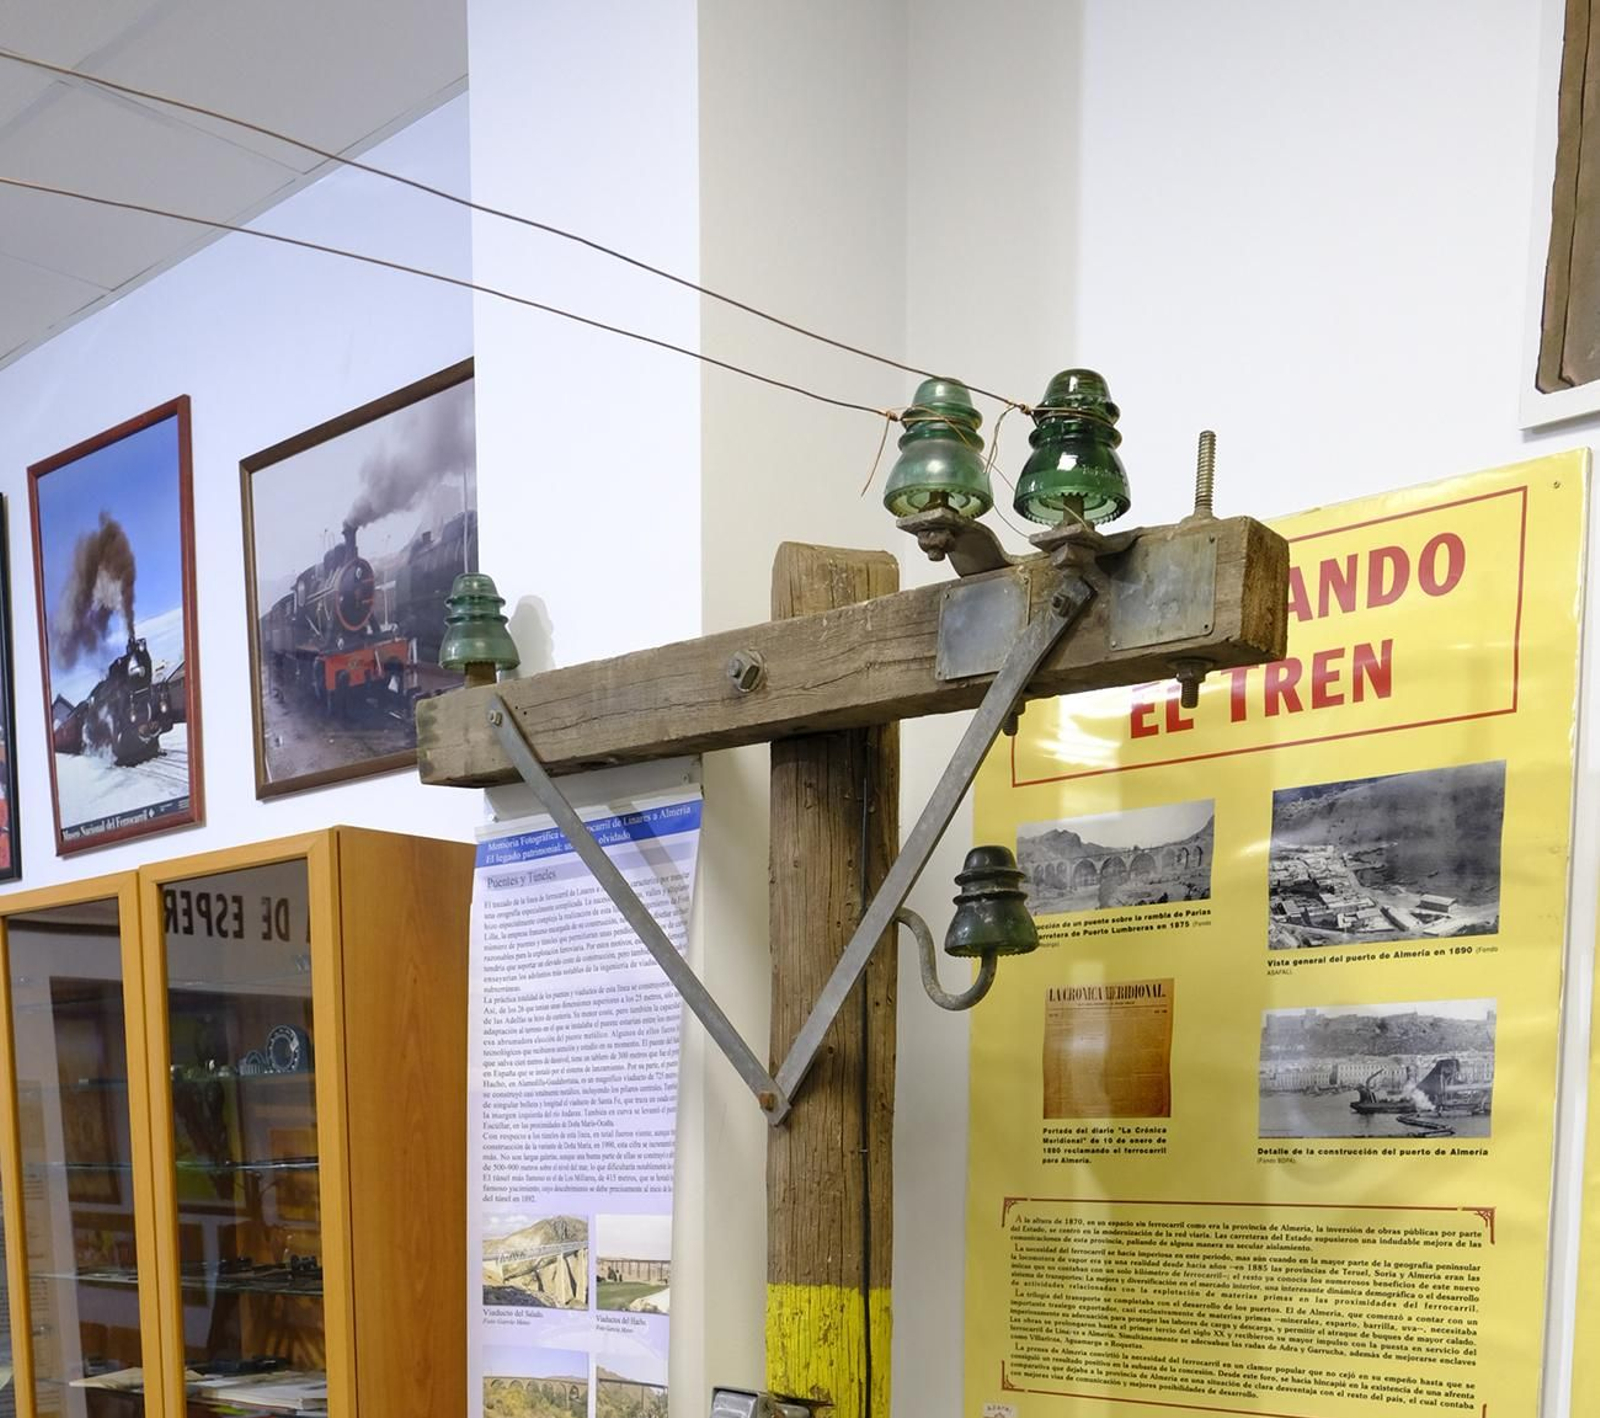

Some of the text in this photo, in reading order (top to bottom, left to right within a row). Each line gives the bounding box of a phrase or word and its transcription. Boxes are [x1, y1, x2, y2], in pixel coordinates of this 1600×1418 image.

[1130, 639, 1393, 739] EL TREN
[488, 840, 519, 852] Memoria
[487, 875, 518, 888] Puentes
[1062, 921, 1071, 929] de
[1083, 917, 1110, 928] puente
[1111, 914, 1133, 924] sobre
[1134, 914, 1142, 922] la
[1144, 911, 1171, 921] rambla
[1173, 910, 1184, 918] de
[1071, 928, 1081, 937] de
[1083, 927, 1109, 937] Puerto
[1111, 924, 1154, 935] Lumbreras
[1157, 922, 1167, 931] en
[1170, 920, 1190, 929] 1875
[1267, 957, 1290, 968] Vista
[1292, 955, 1327, 968] general
[1329, 954, 1344, 963] del
[1345, 952, 1377, 964] puerto
[1379, 951, 1391, 960] de
[1393, 948, 1431, 959] Almería
[1433, 947, 1446, 956] en
[1449, 945, 1473, 955] 1890
[1049, 987, 1062, 1002] LA
[1042, 1126, 1073, 1135] Portada
[1075, 1126, 1088, 1135] del
[1091, 1126, 1115, 1135] diario
[1135, 1125, 1167, 1135] Crónica
[1090, 1136, 1100, 1145] de
[1103, 1136, 1113, 1145] 10
[1116, 1136, 1126, 1145] de
[1129, 1137, 1152, 1145] enero
[1156, 1136, 1167, 1145] de
[1064, 1146, 1111, 1155] reclamando
[1113, 1146, 1121, 1155] el
[1124, 1146, 1167, 1155] ferrocarril
[1257, 1147, 1489, 1158] Detalle de la construcción del puerto de Almería
[1042, 1157, 1059, 1166] para
[1108, 1219, 1133, 1228] espacio
[1148, 1220, 1184, 1228] ferrocarril
[1232, 1223, 1266, 1232] provincia
[1280, 1224, 1313, 1233] Almería,
[1326, 1225, 1362, 1233] inversión
[1377, 1227, 1400, 1235] obras
[1403, 1228, 1438, 1238] públicas
[1459, 1229, 1481, 1239] parte
[1102, 1227, 1152, 1235] modernización
[1229, 1231, 1268, 1239] carreteras
[1285, 1233, 1312, 1241] Estado
[1314, 1234, 1358, 1244] supusieron
[1379, 1236, 1419, 1245] indudable
[1423, 1239, 1452, 1248] mejora
[1469, 1239, 1481, 1247] las
